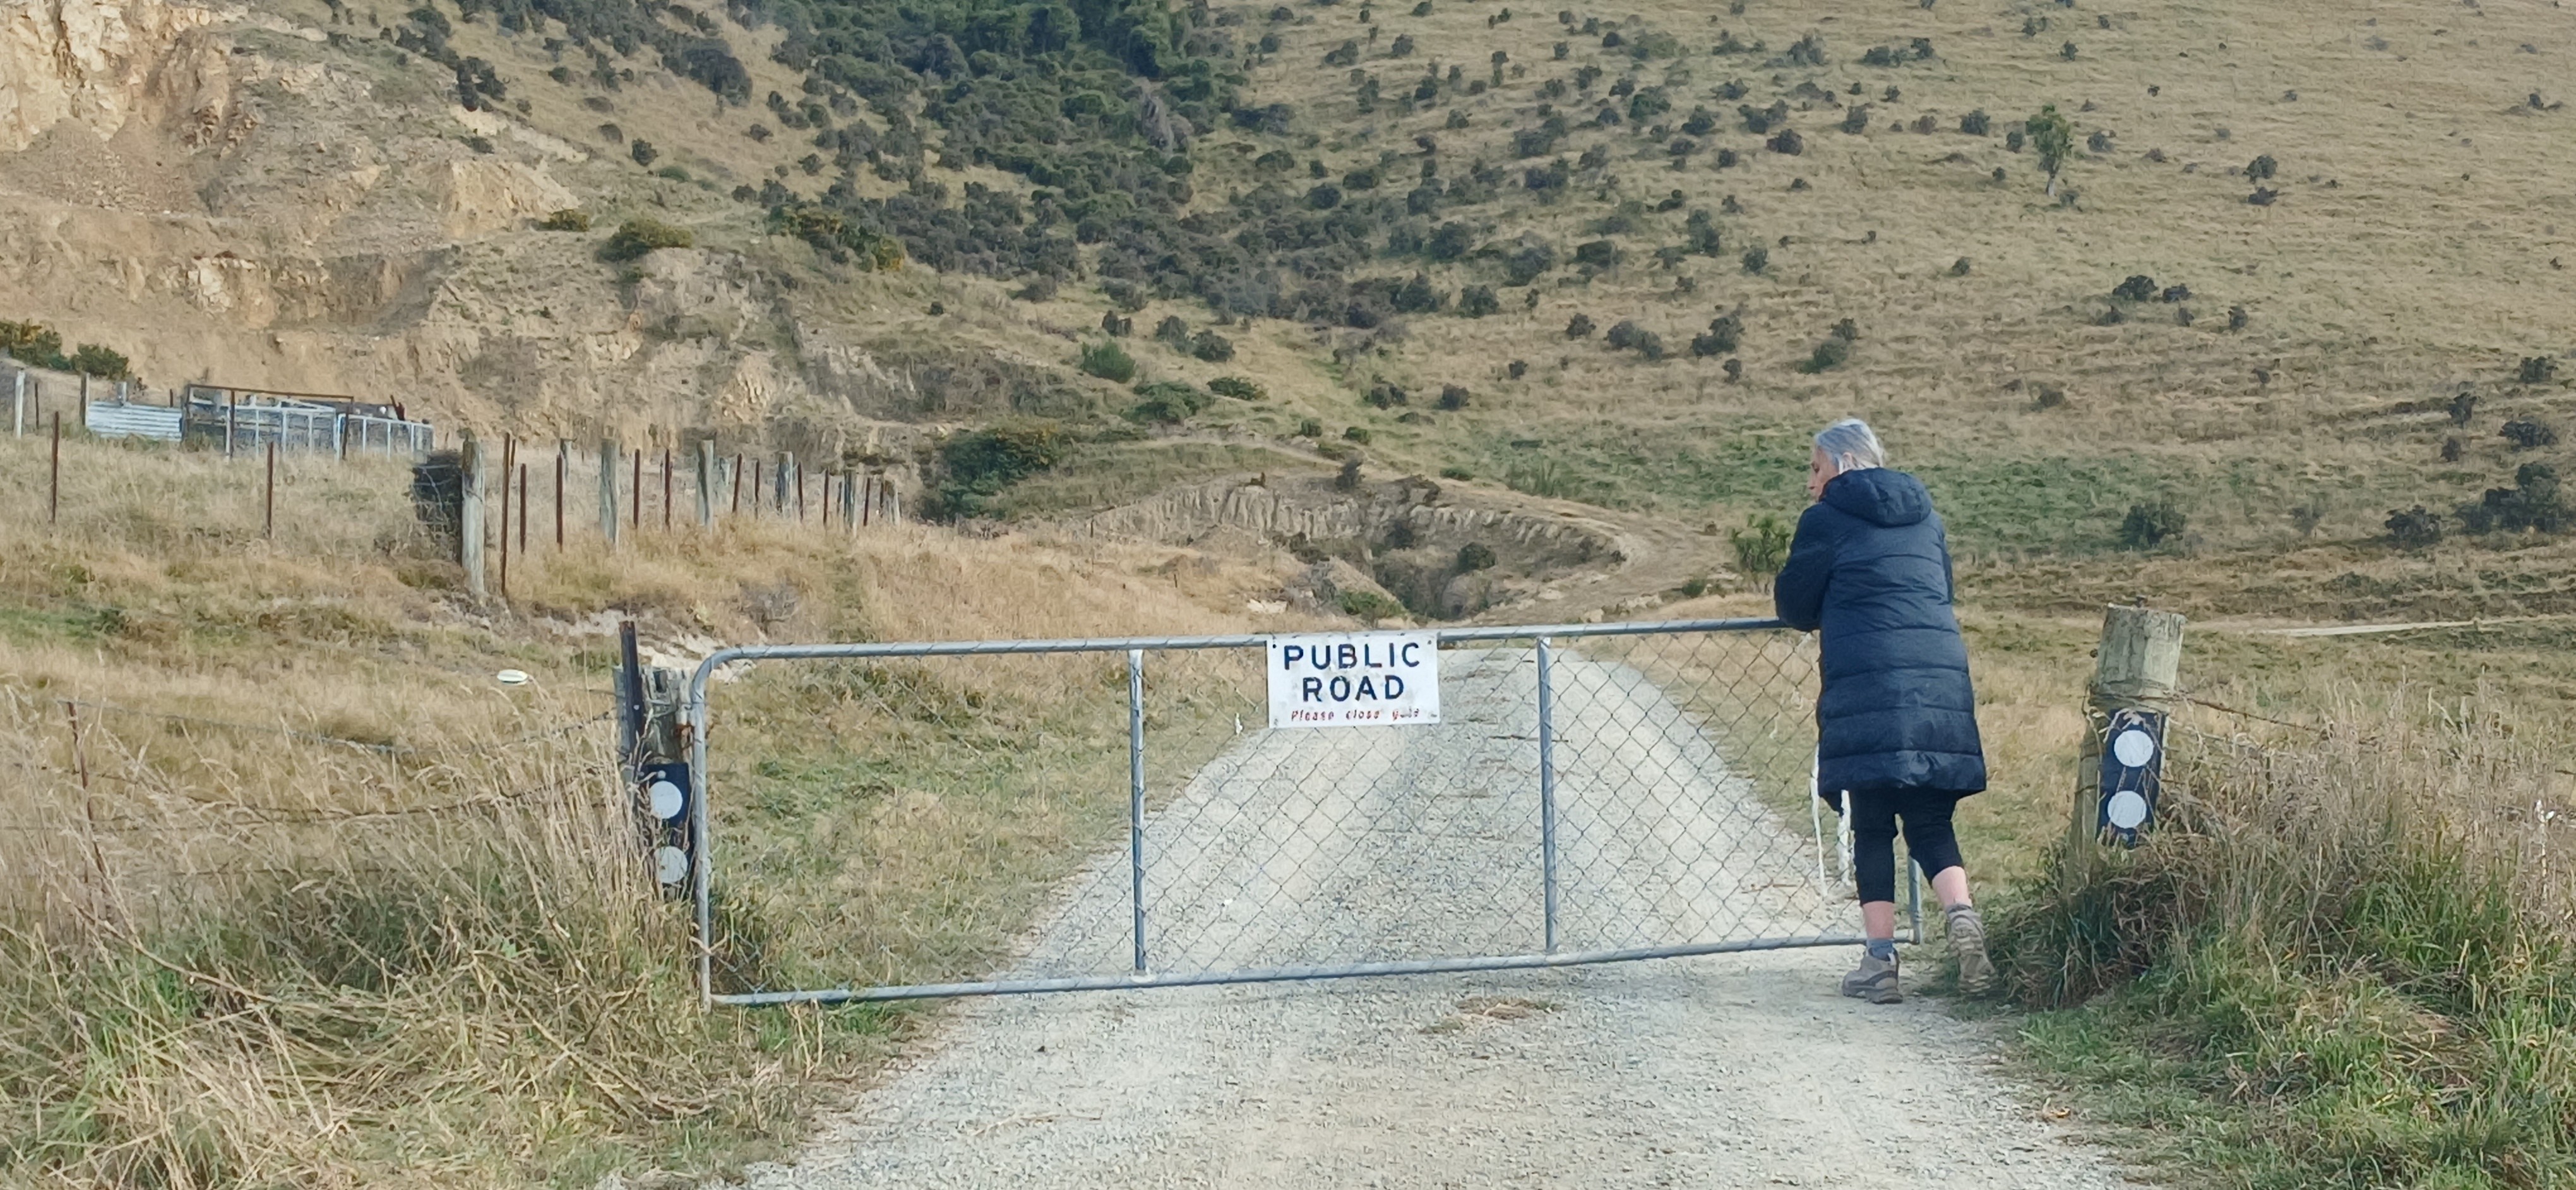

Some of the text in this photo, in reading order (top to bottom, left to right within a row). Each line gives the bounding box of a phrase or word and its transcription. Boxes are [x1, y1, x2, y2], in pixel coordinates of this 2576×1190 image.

[1284, 642, 1420, 670] PUBLIC
[1303, 675, 1404, 702] ROAD
[1291, 709, 1334, 722] Please
